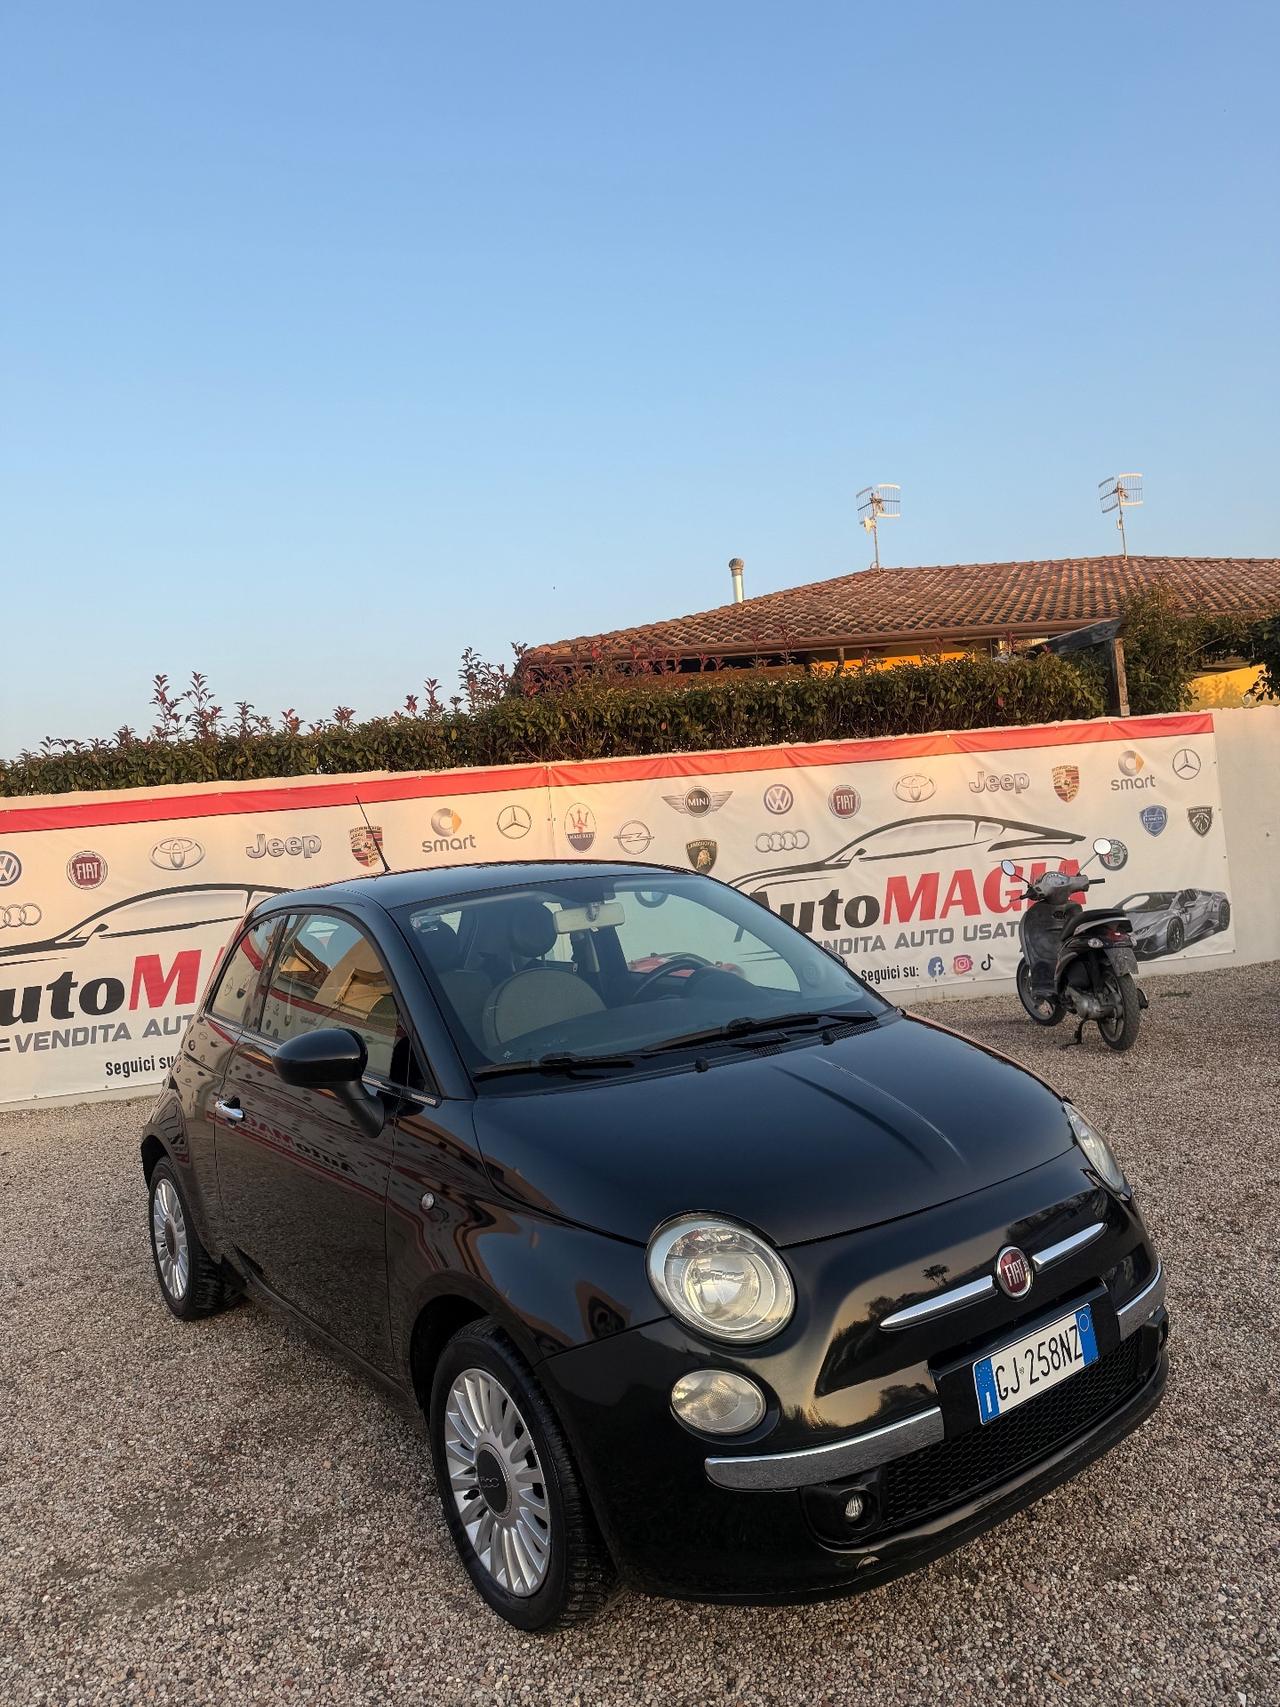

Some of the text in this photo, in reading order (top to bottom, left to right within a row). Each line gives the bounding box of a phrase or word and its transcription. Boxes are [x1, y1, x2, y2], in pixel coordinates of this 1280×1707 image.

[969, 770, 1030, 794] Jeep
[1110, 774, 1156, 791] smart
[688, 797, 709, 807] MINI
[835, 794, 854, 810] FIAT
[245, 833, 322, 859] Jeep
[421, 834, 477, 853] smart
[76, 861, 99, 880] FIAT
[817, 920, 1019, 955] NDITA AUTO USAT
[860, 968, 900, 984] Seguici
[903, 965, 920, 978] su:
[14, 1022, 132, 1053] VENDITA
[105, 1055, 155, 1078] Seguici
[1004, 1258, 1025, 1287] FIAT
[994, 1324, 1085, 1401] GJ 258NZ
